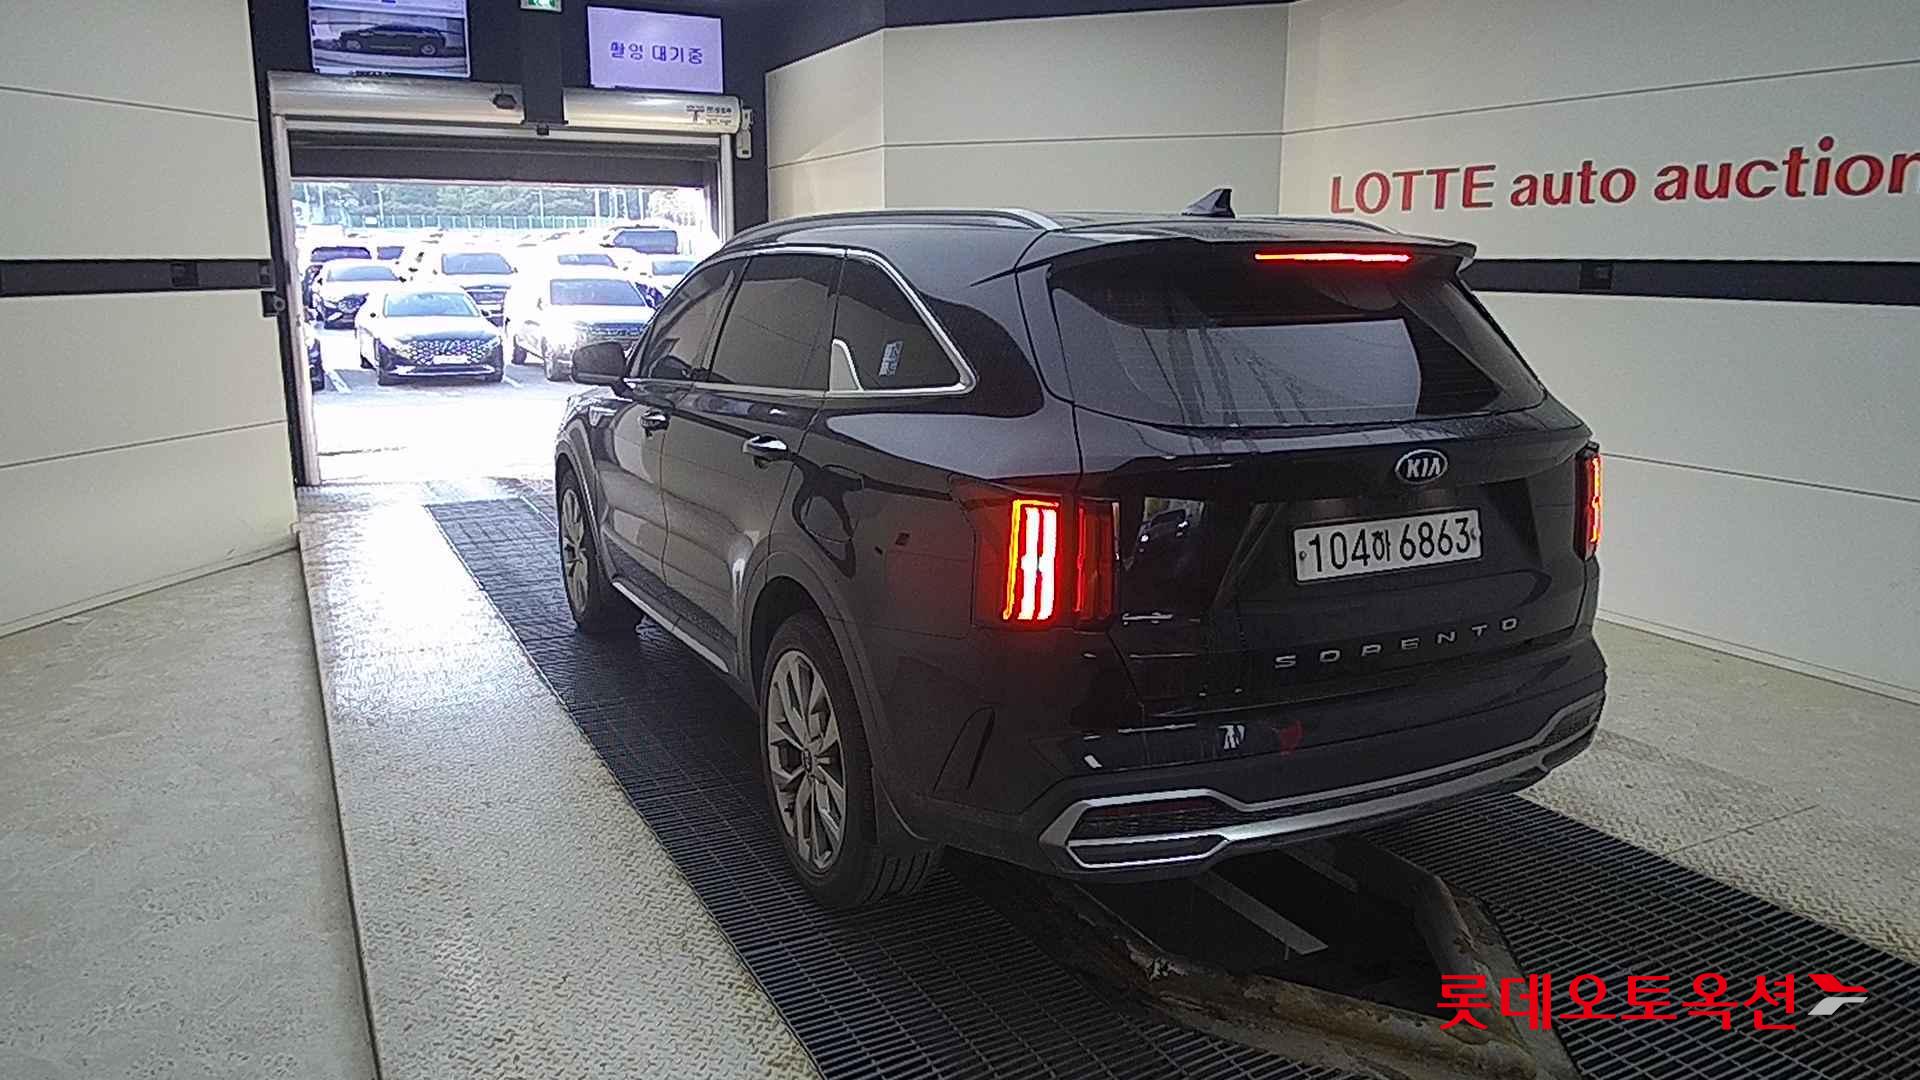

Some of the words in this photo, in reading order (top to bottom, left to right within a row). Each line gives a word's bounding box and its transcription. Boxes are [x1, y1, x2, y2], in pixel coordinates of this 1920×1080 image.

[652, 44, 703, 65] 대기중
[1330, 164, 1496, 214] LOTTE
[1510, 160, 1637, 208] auto
[1405, 457, 1442, 478] KIA
[1274, 616, 1519, 670] SORENTO
